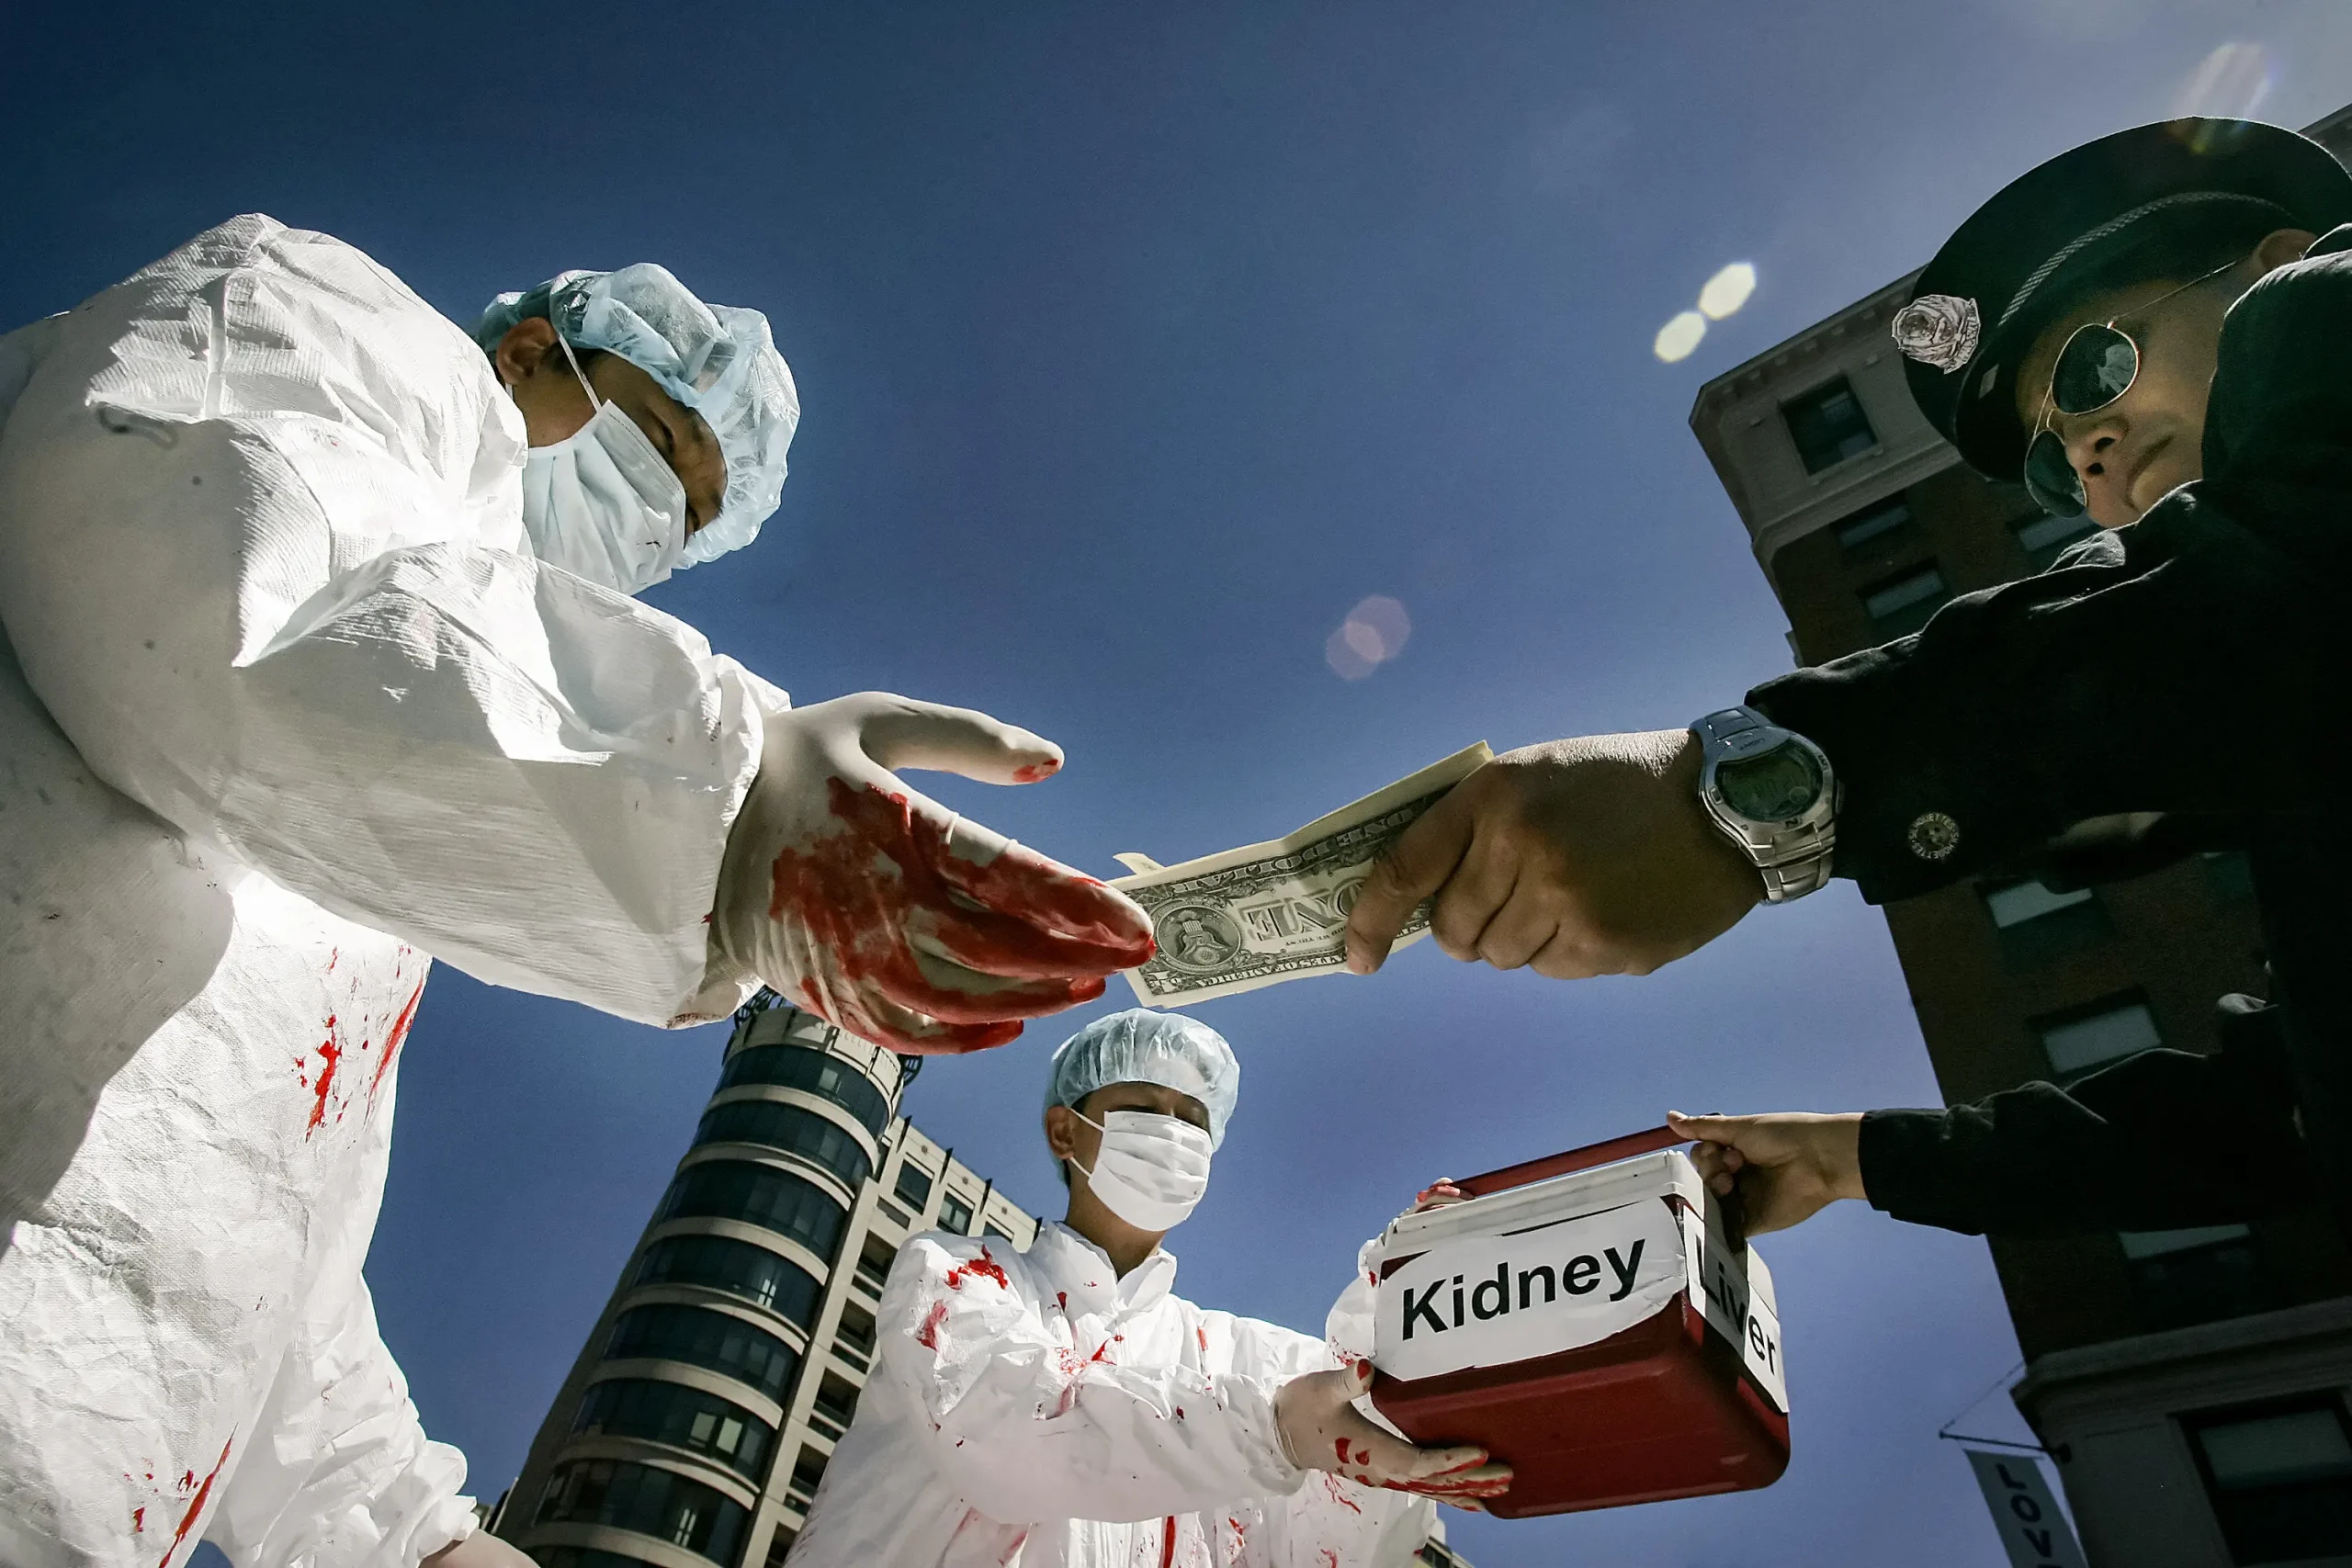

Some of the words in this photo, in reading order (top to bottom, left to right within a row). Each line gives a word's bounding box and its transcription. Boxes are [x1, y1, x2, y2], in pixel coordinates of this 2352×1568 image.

[1169, 840, 1331, 894] DOLLAR
[1195, 964, 1272, 987] AMERICA
[1273, 960, 1298, 973] OF
[1402, 1238, 1645, 1341] Kidney
[1695, 1235, 1777, 1376] Liver
[1995, 1462, 2064, 1568] LOV
